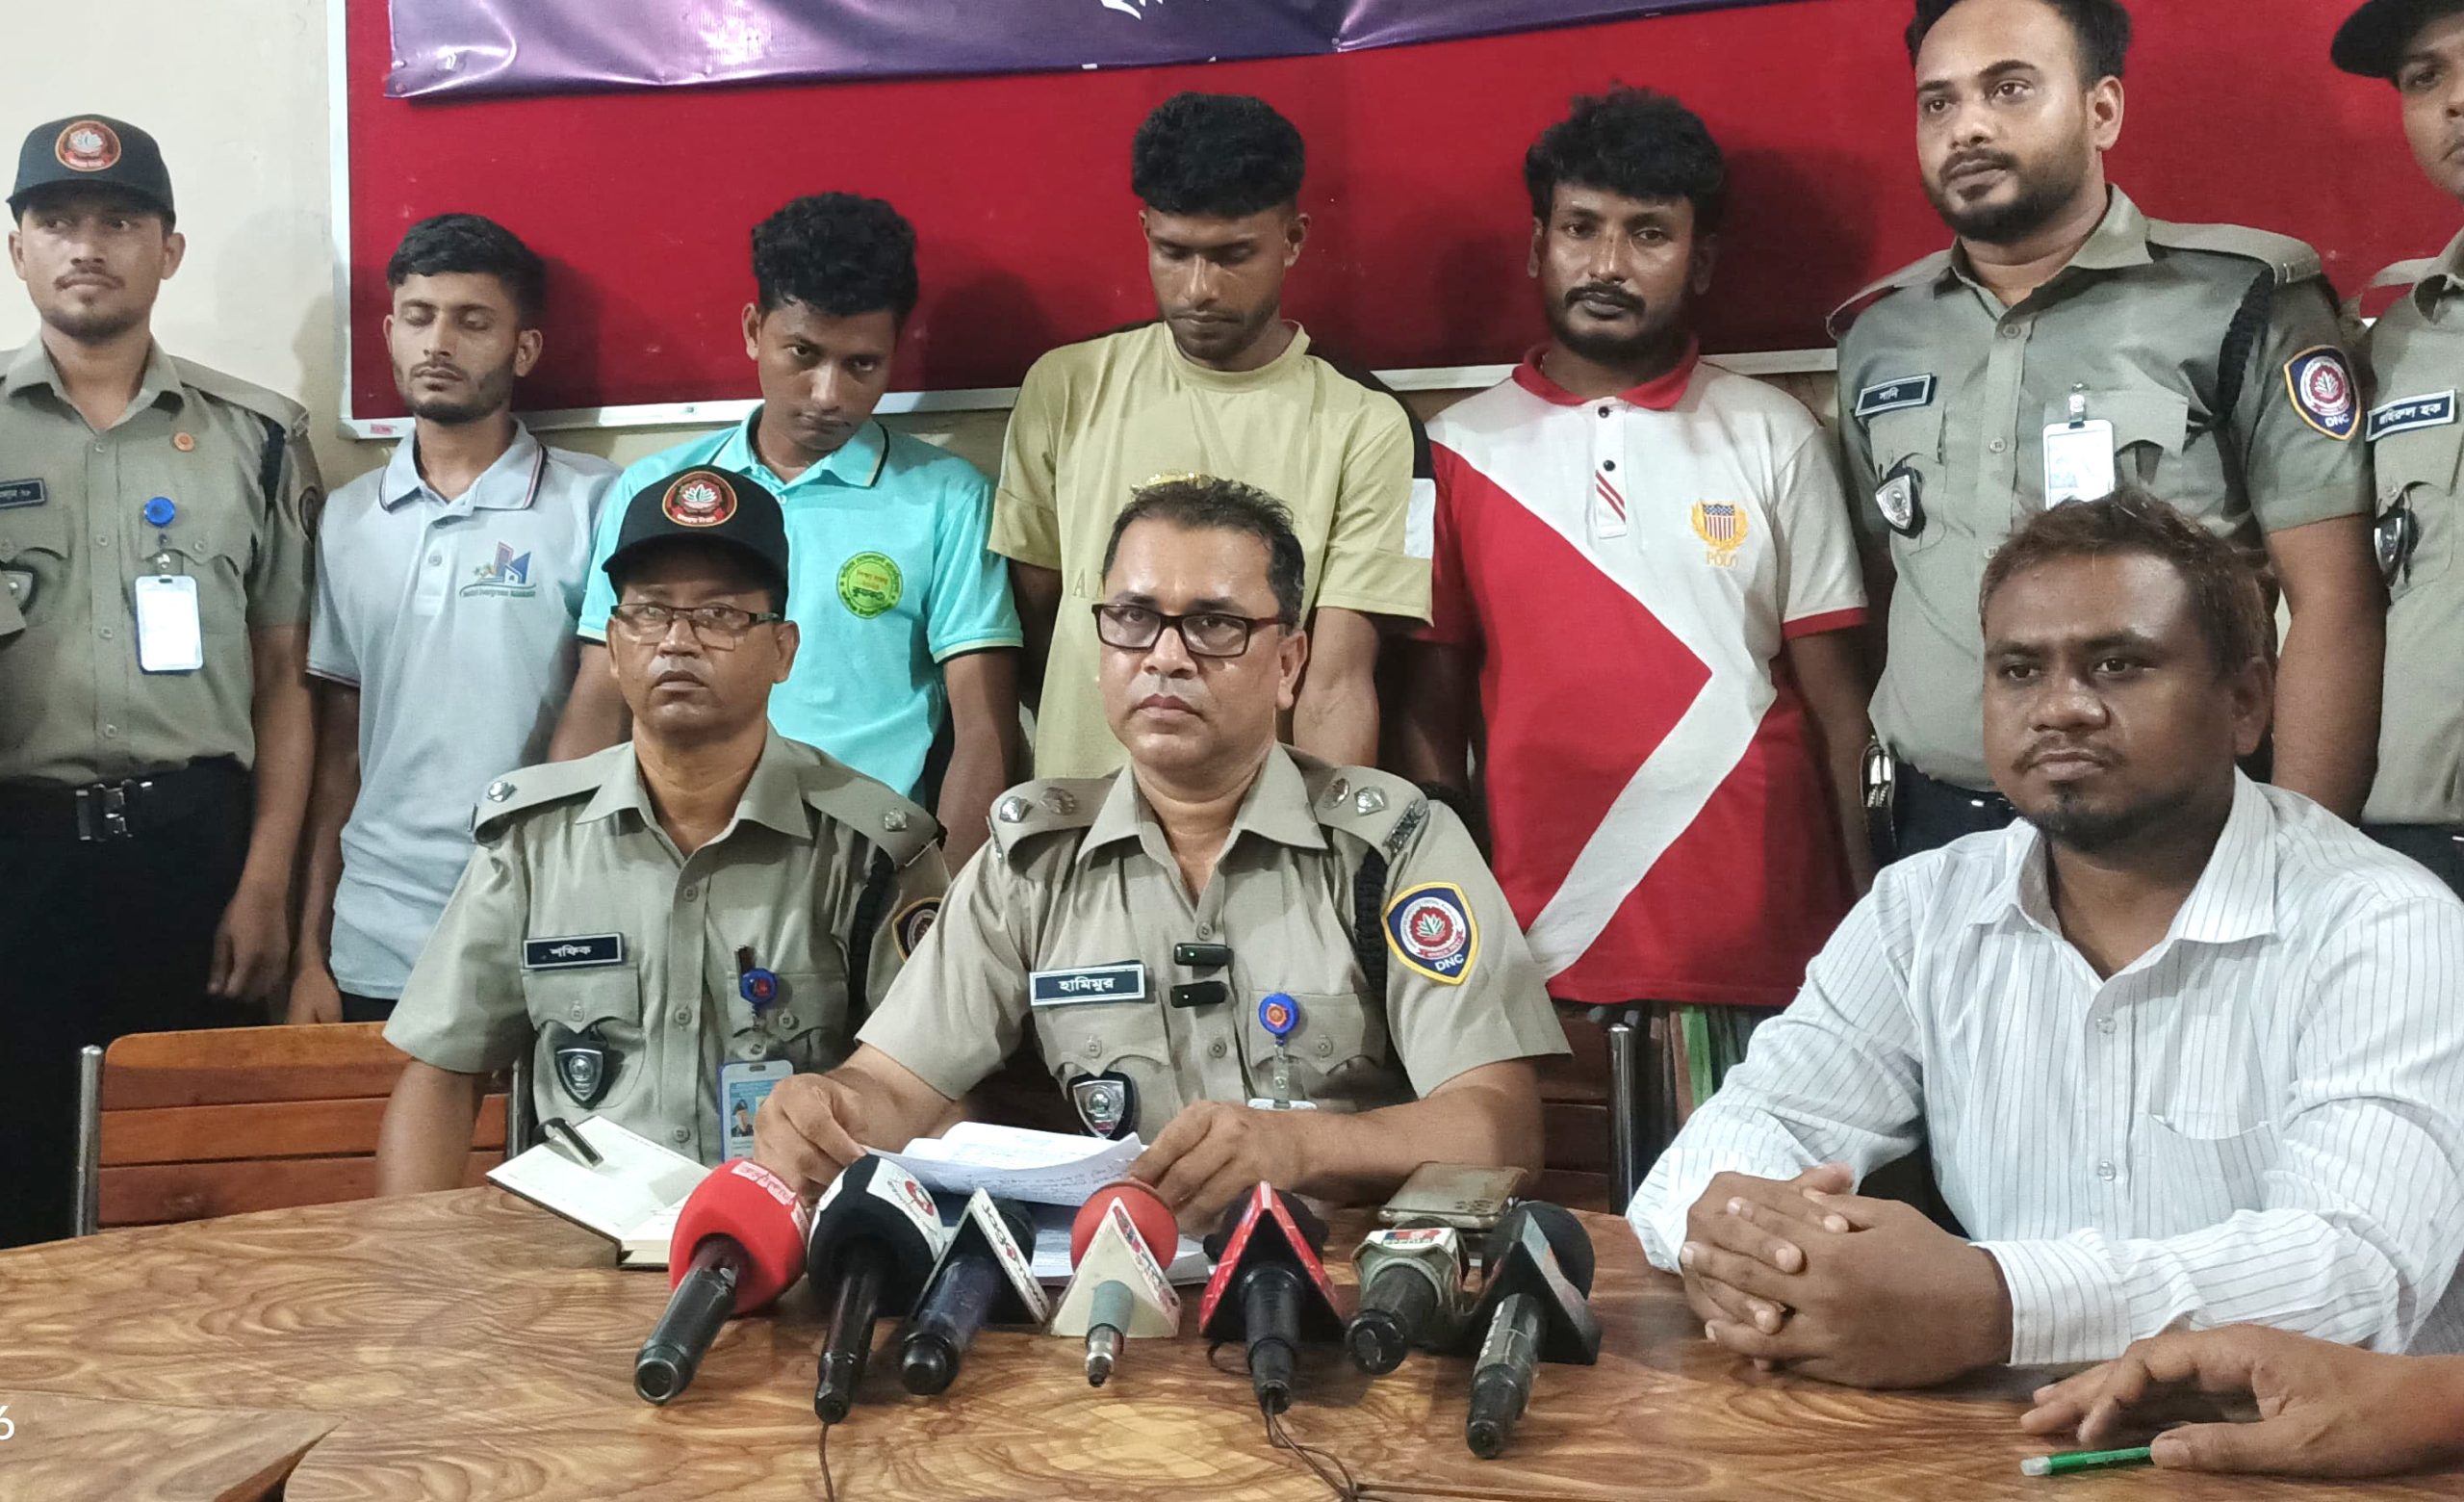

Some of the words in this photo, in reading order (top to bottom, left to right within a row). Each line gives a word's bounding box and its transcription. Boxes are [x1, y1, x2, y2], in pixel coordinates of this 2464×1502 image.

[2420, 402, 2442, 417] হক
[2324, 414, 2349, 427] DNC
[549, 945, 592, 957] শফিক
[1434, 954, 1465, 971] DNC
[1058, 975, 1116, 993] হামিমুর
